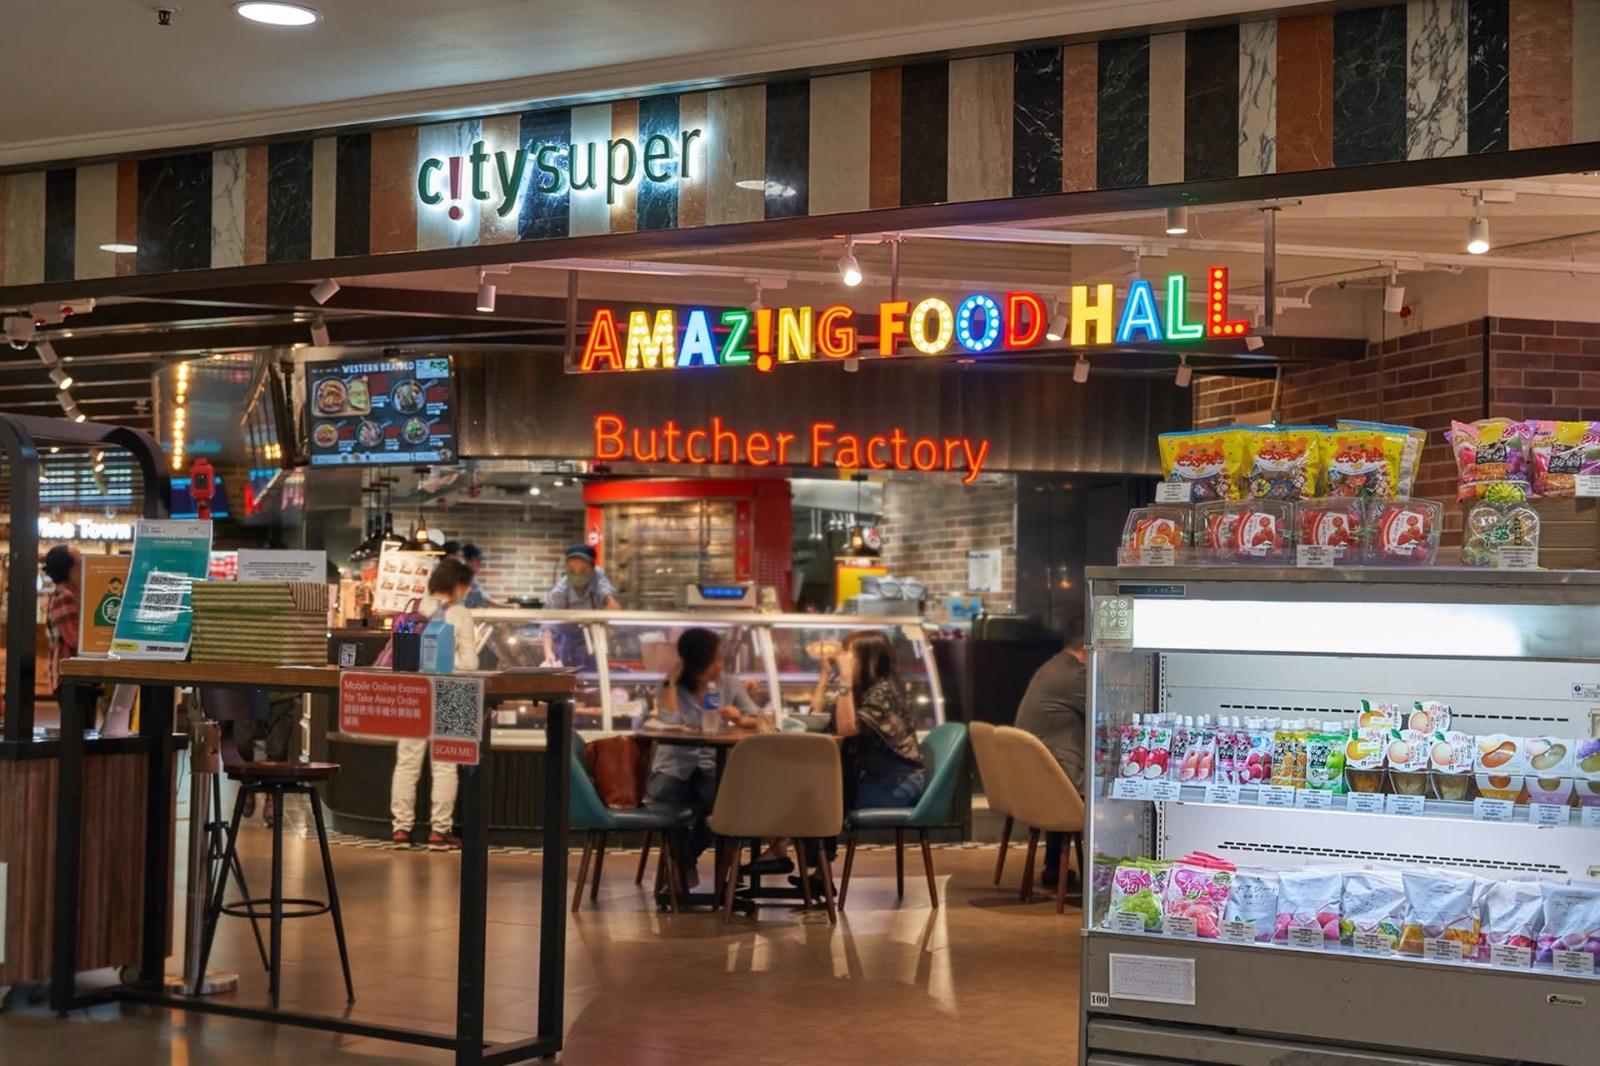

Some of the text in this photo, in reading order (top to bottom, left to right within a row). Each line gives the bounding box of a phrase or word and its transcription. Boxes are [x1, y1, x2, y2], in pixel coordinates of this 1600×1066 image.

[580, 265, 1250, 372] AMAZ!NG FOOD HALL
[594, 414, 991, 485] Butcher Factory
[77, 518, 131, 539] Town
[344, 681, 428, 695] Mobile Online Express
[344, 692, 419, 706] for Take Away Order
[434, 744, 457, 756] SCAN
[1092, 995, 1108, 1004] 100
